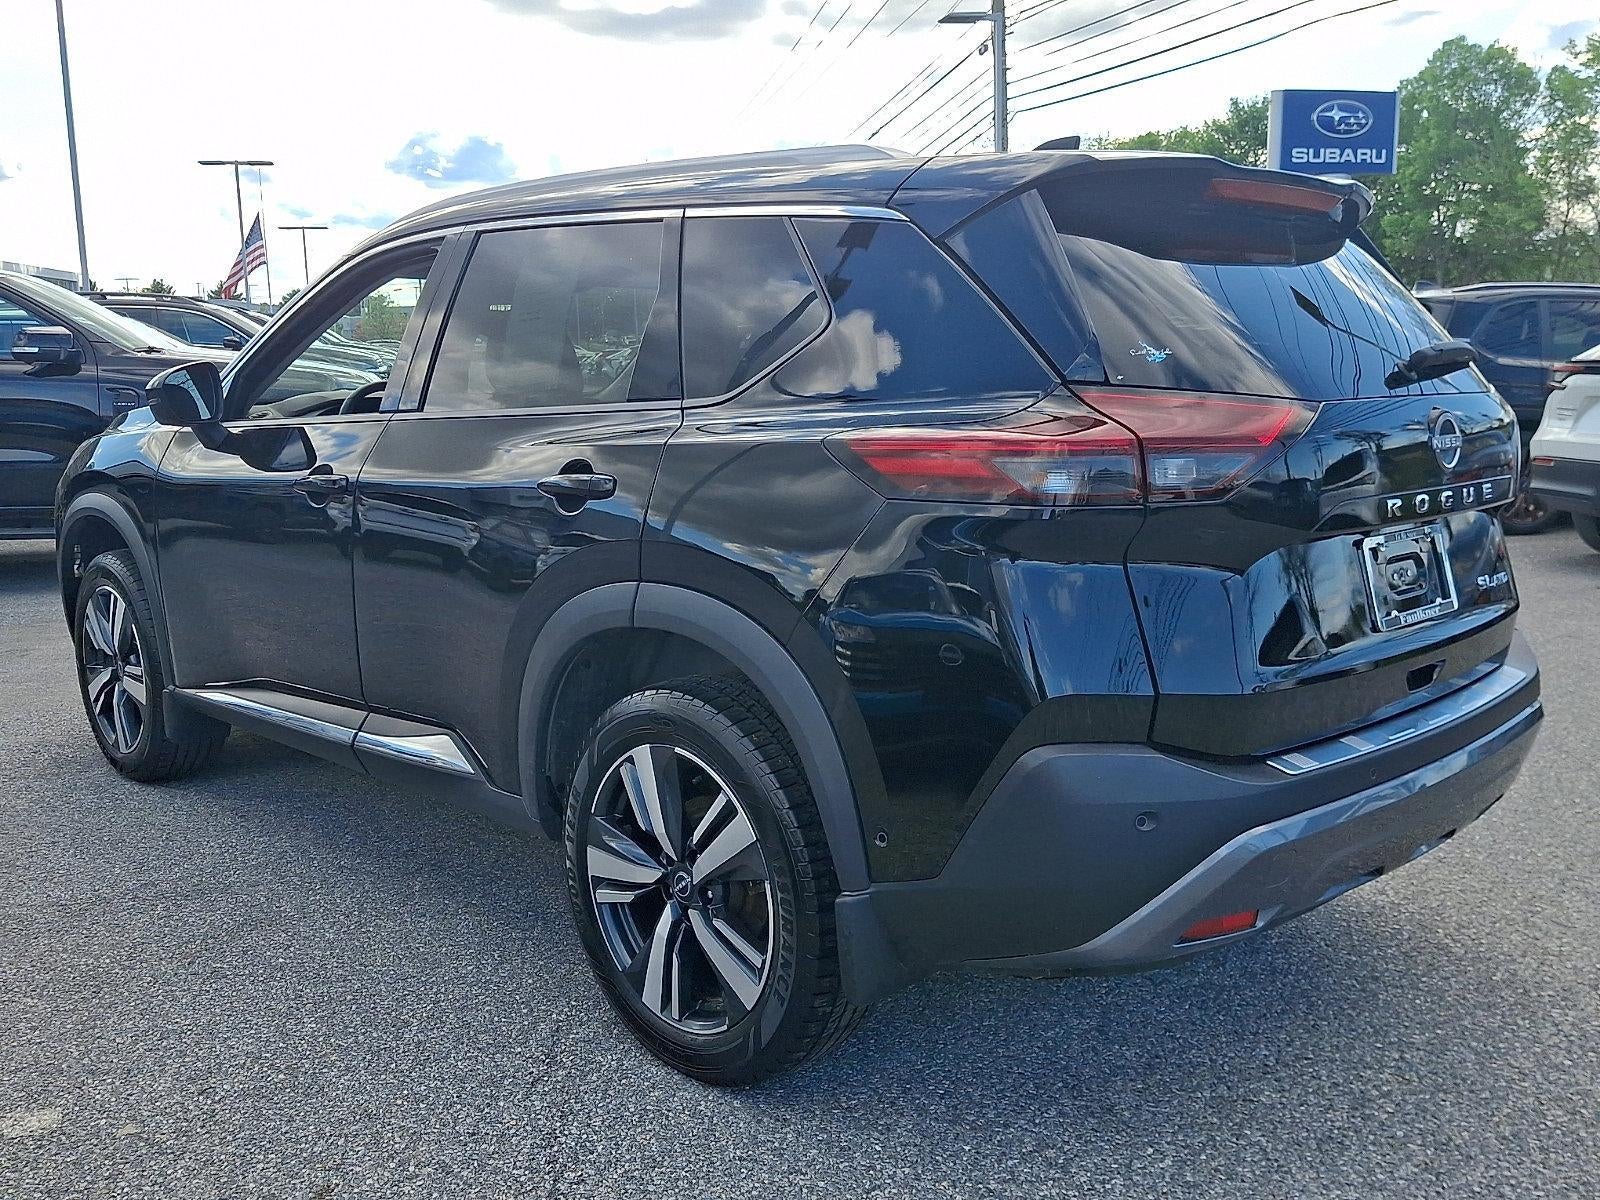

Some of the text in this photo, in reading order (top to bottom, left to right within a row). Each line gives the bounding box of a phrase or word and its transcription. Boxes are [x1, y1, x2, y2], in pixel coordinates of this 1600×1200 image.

[1291, 147, 1387, 164] SUBARU
[1432, 437, 1461, 449] NISS
[1386, 482, 1493, 518] ROGUE
[1400, 606, 1441, 625] Faulkner
